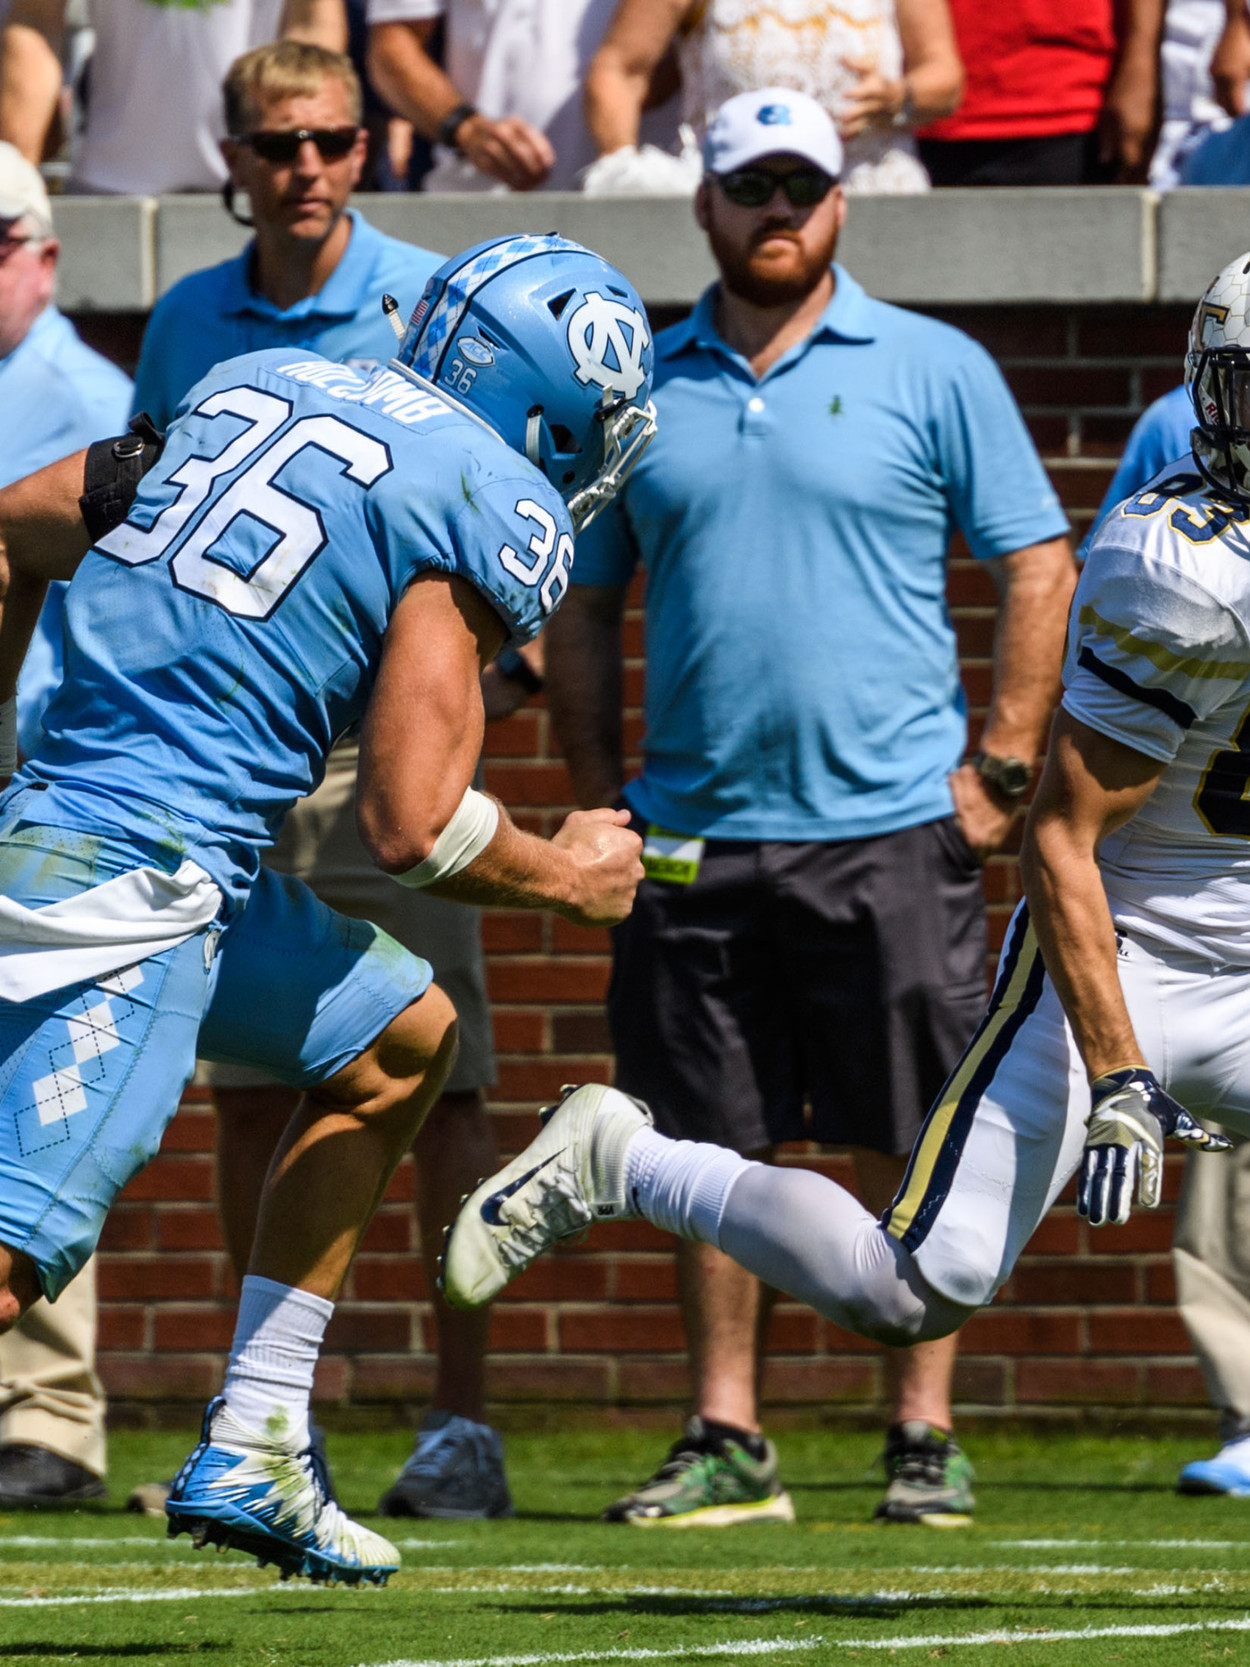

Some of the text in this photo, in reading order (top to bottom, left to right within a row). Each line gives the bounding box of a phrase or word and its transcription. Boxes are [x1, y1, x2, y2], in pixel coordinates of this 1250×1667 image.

[444, 358, 478, 395] 36
[464, 340, 489, 361] ACC
[93, 384, 395, 622] 36
[498, 498, 575, 616] 36
